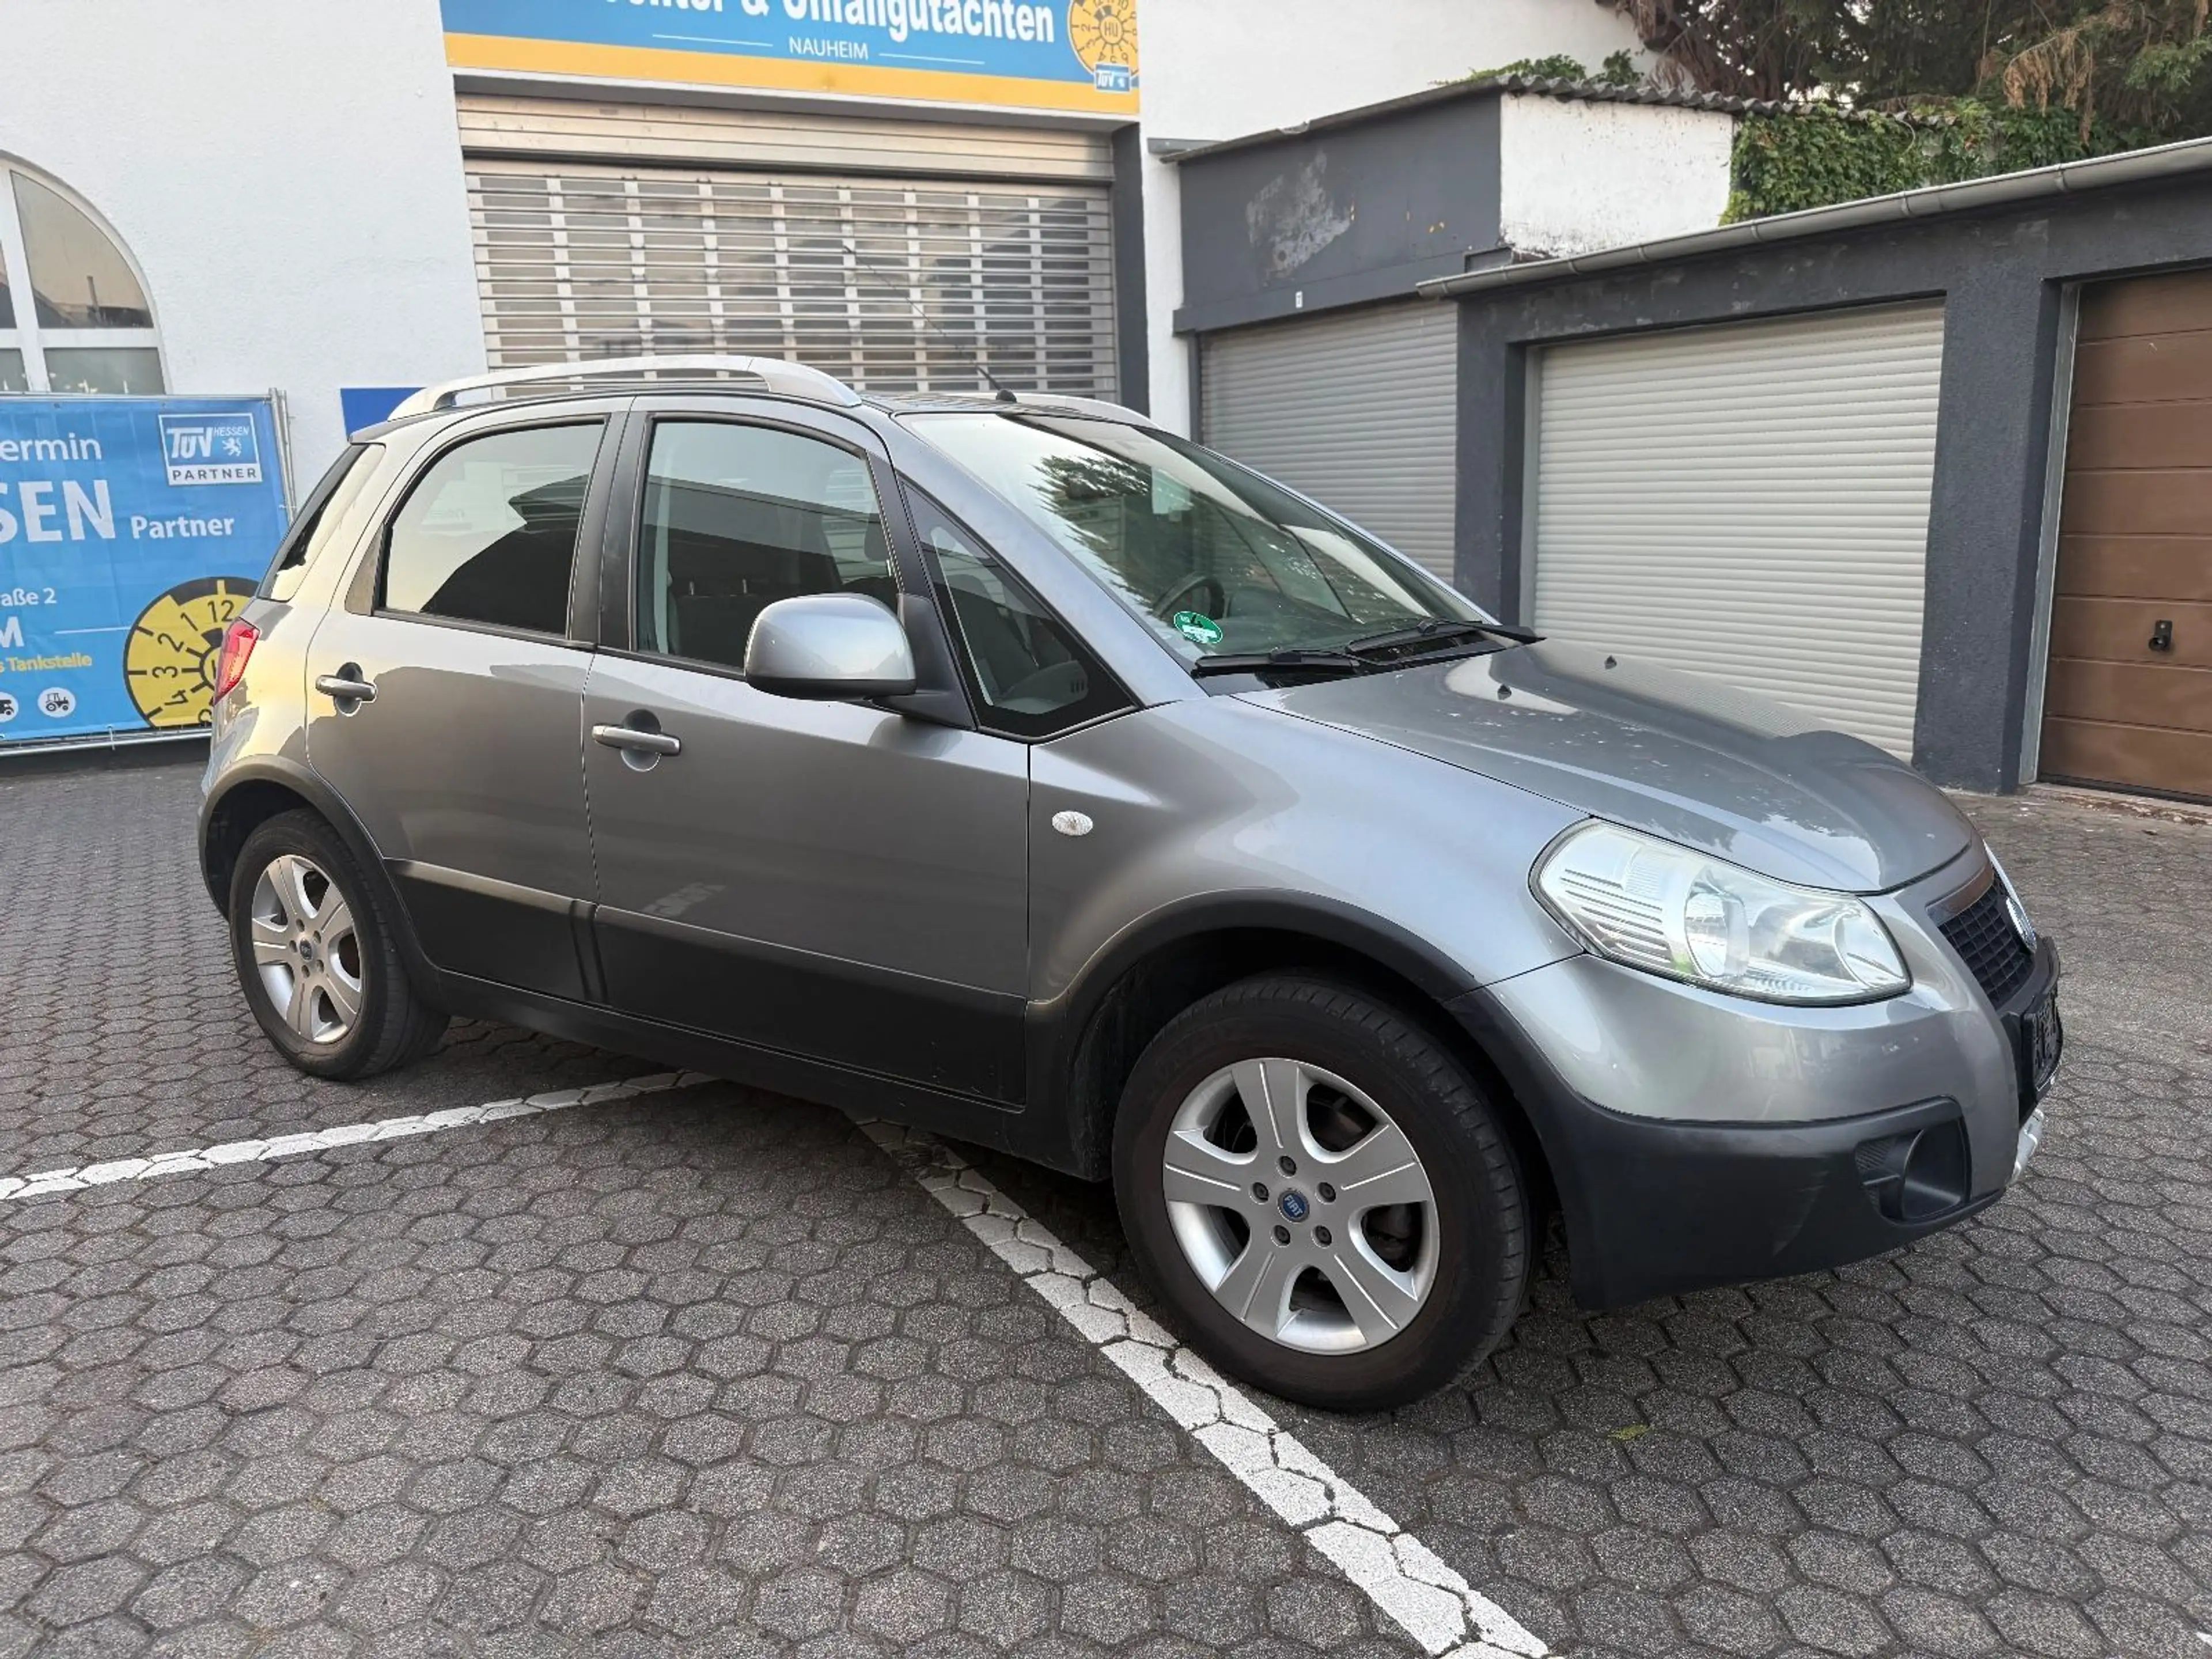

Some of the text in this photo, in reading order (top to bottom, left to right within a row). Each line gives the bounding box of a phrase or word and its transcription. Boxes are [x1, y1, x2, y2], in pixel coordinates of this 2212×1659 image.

[789, 36, 868, 60] NAUHEIM
[0, 432, 102, 461] ermin
[166, 425, 250, 459] TÜV HESSEN
[172, 467, 257, 482] PARTNER
[131, 516, 234, 539] Partner
[43, 587, 57, 604] 2
[180, 612, 199, 632] 1
[207, 600, 235, 623] 12
[157, 632, 184, 653] 2
[5, 652, 93, 672] Tankstelle
[152, 666, 179, 679] 3
[164, 689, 188, 706] 4
[1284, 1194, 1304, 1217] FIAT
